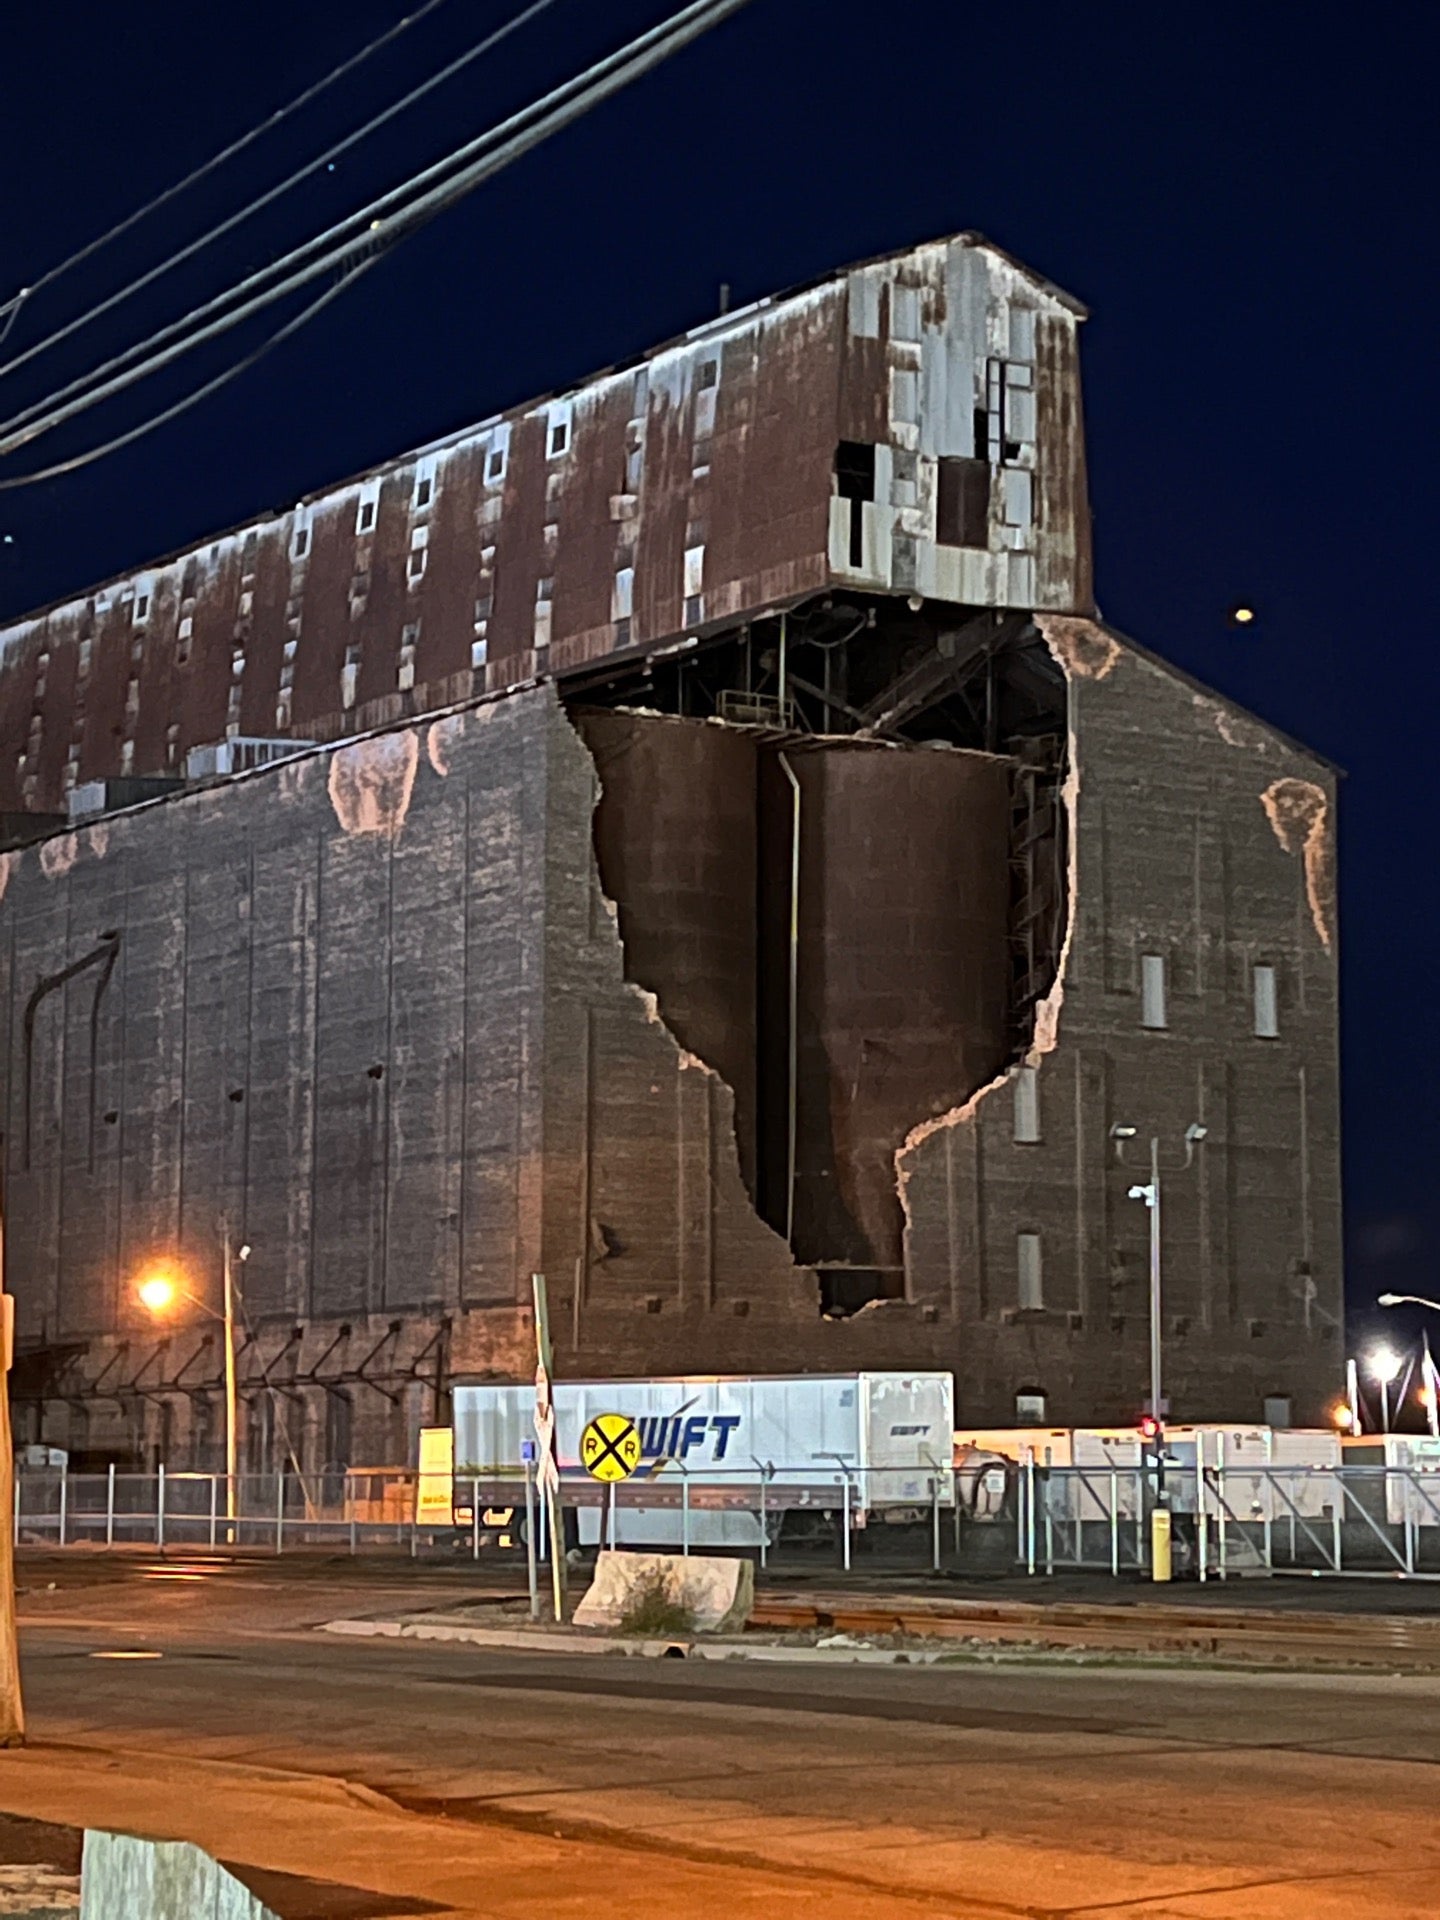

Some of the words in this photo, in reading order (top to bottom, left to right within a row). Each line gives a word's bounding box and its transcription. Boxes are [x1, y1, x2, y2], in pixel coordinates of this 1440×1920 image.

[586, 1437, 597, 1454] R
[625, 1440, 636, 1458] R
[628, 1415, 741, 1461] WIFT
